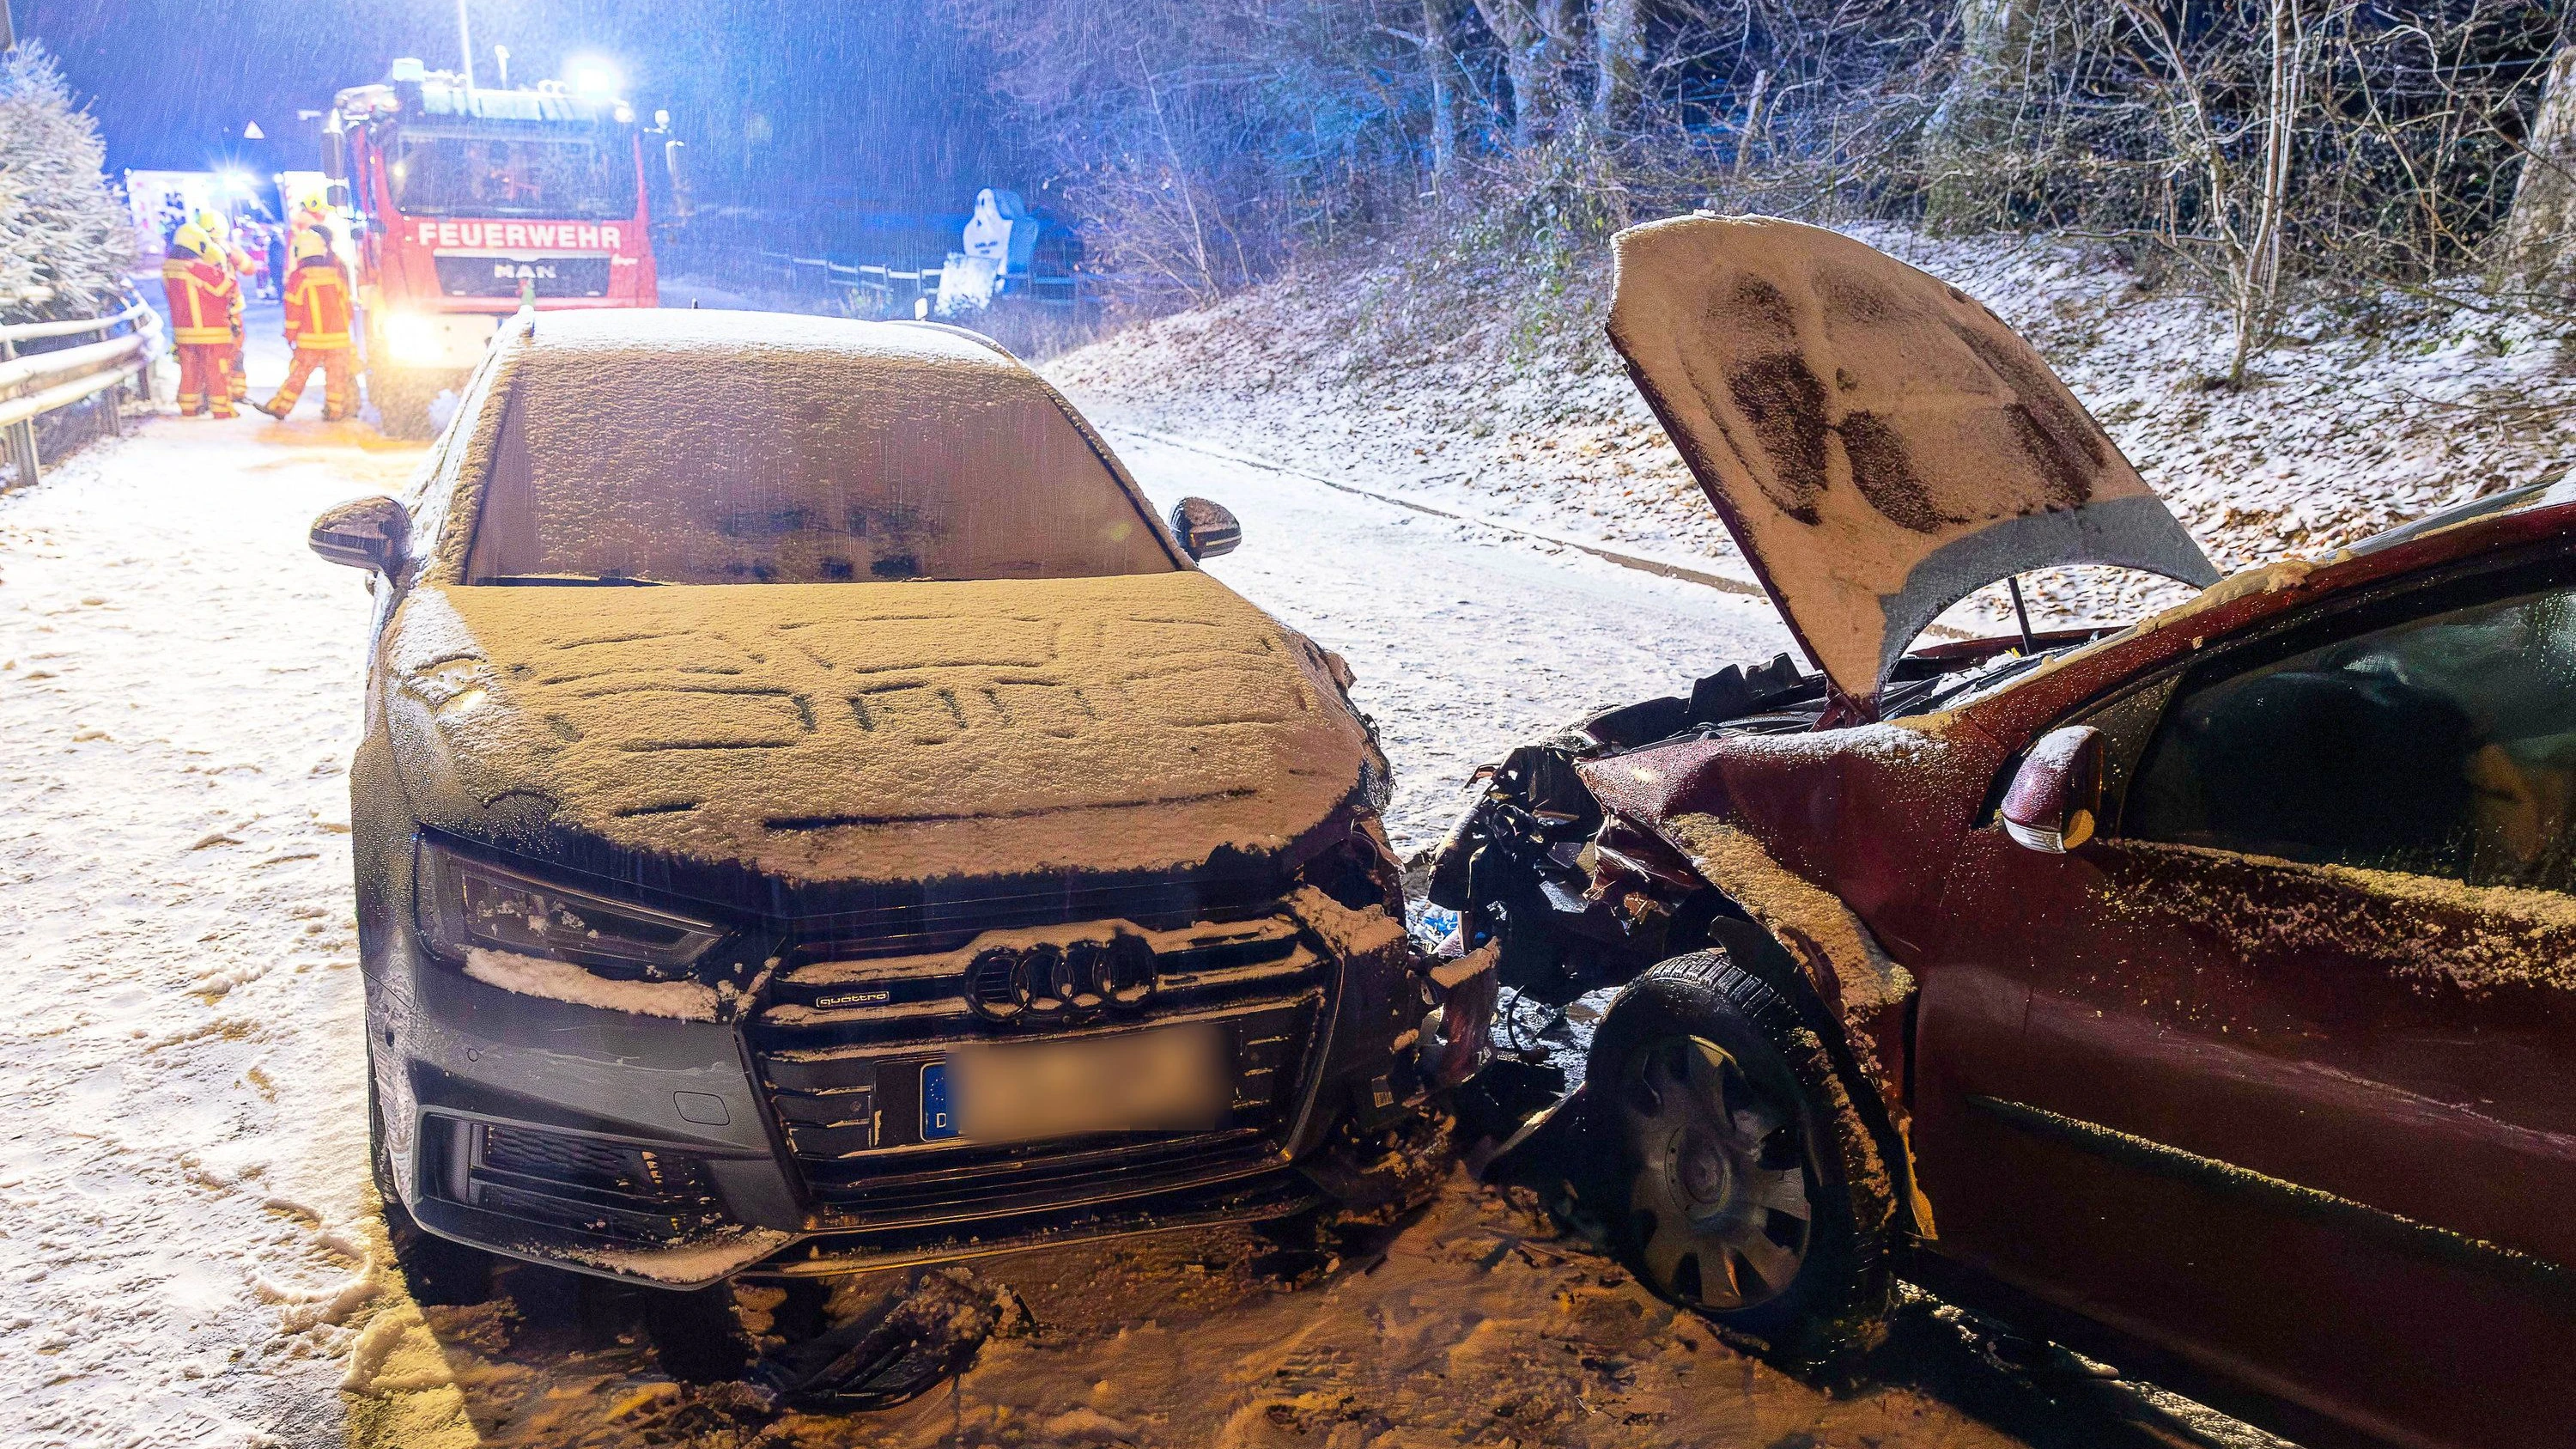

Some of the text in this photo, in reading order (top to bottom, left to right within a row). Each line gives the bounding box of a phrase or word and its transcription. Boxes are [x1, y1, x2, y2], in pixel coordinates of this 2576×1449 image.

[418, 222, 621, 248] FEUERWEHR
[494, 264, 556, 278] MAN
[820, 994, 886, 1006] quattro
[936, 1113, 947, 1129] D
